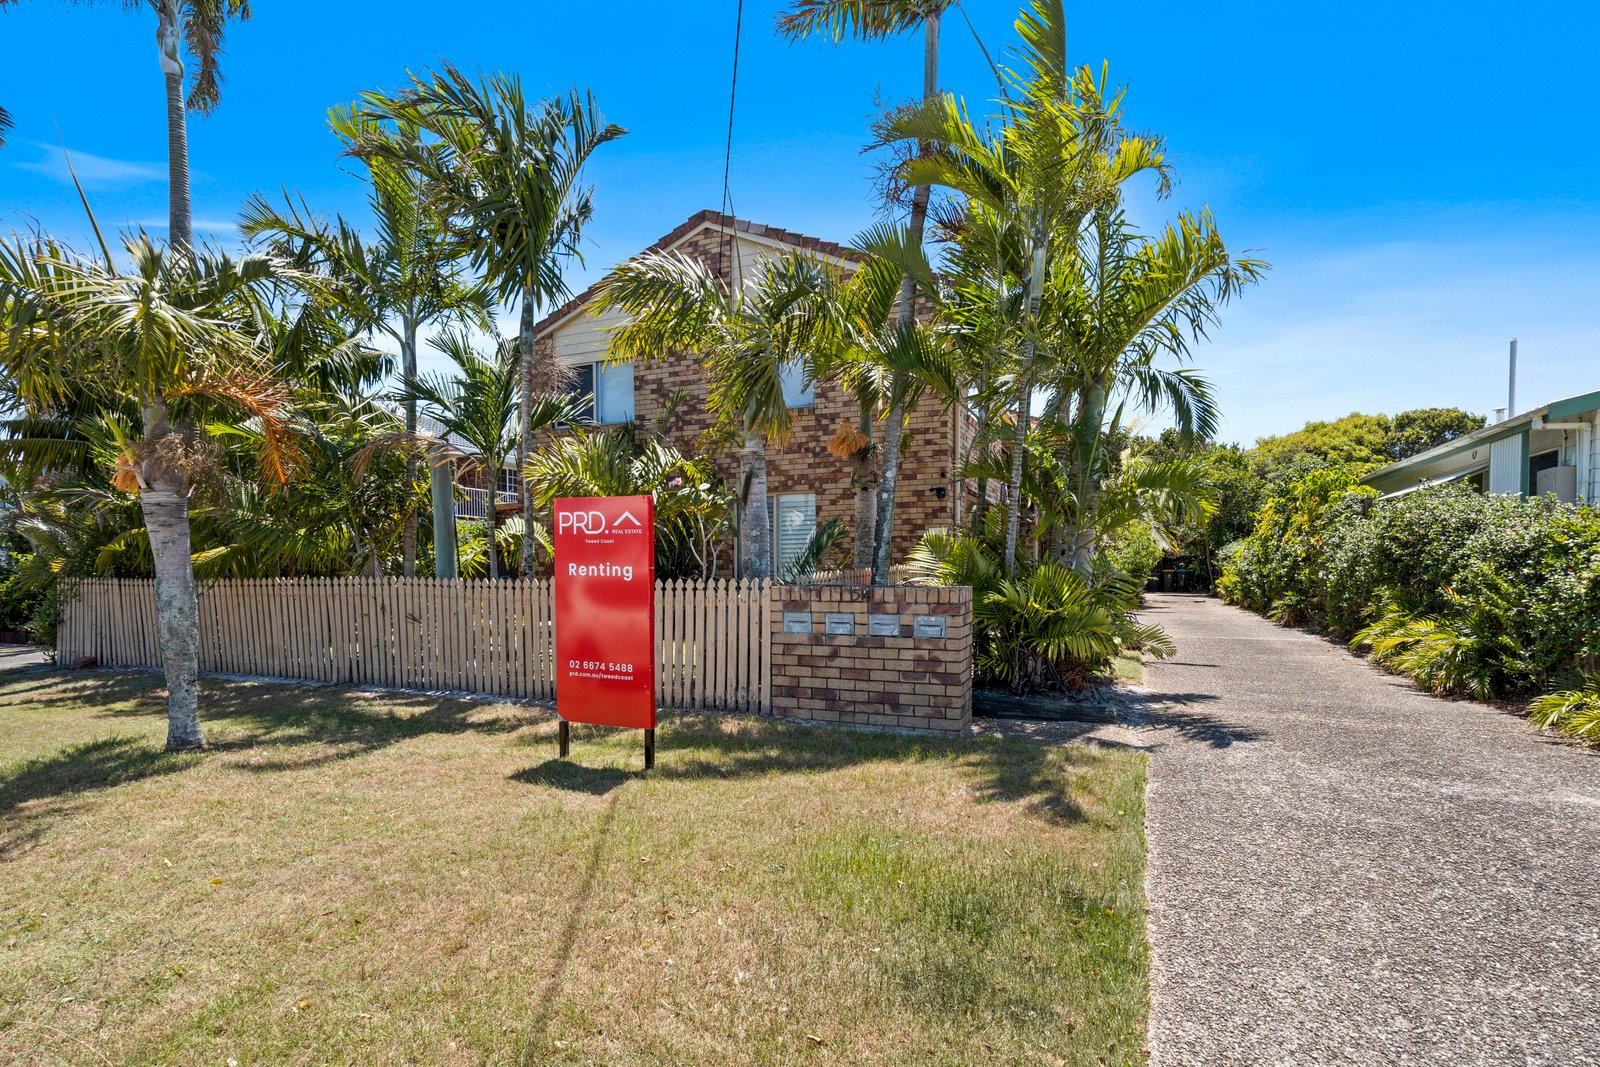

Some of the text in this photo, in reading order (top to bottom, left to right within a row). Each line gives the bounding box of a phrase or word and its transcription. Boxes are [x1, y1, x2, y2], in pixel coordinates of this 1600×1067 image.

[568, 562, 633, 581] Renting
[569, 660, 633, 672] 02 6674 5488
[569, 671, 633, 680] prd.com.au/tweedcoast
